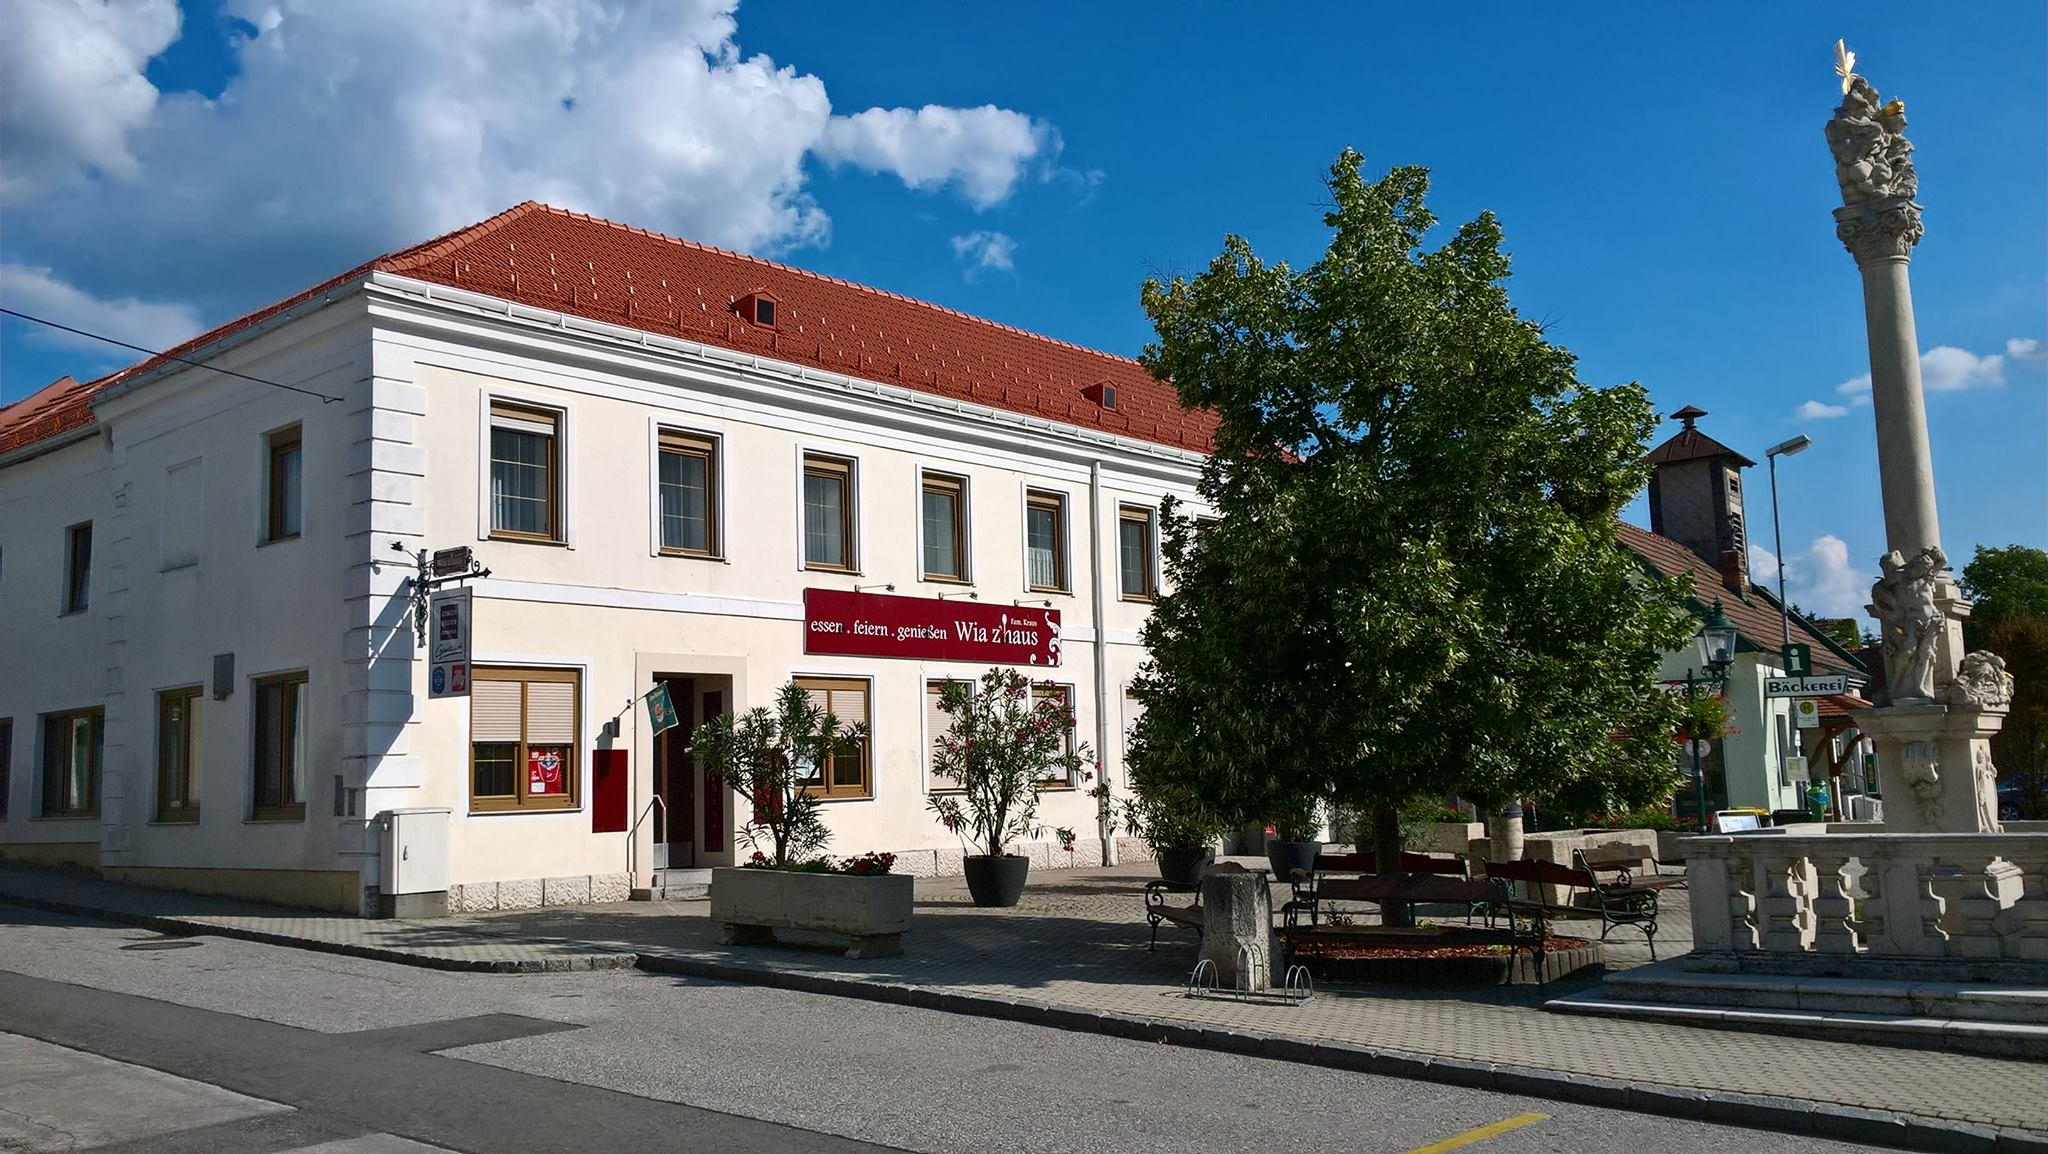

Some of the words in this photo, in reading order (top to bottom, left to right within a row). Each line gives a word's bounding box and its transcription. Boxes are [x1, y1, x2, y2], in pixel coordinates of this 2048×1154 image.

[810, 620, 843, 633] essen
[853, 620, 888, 636] feiern
[897, 624, 947, 641] genießen
[954, 620, 988, 643] Wia
